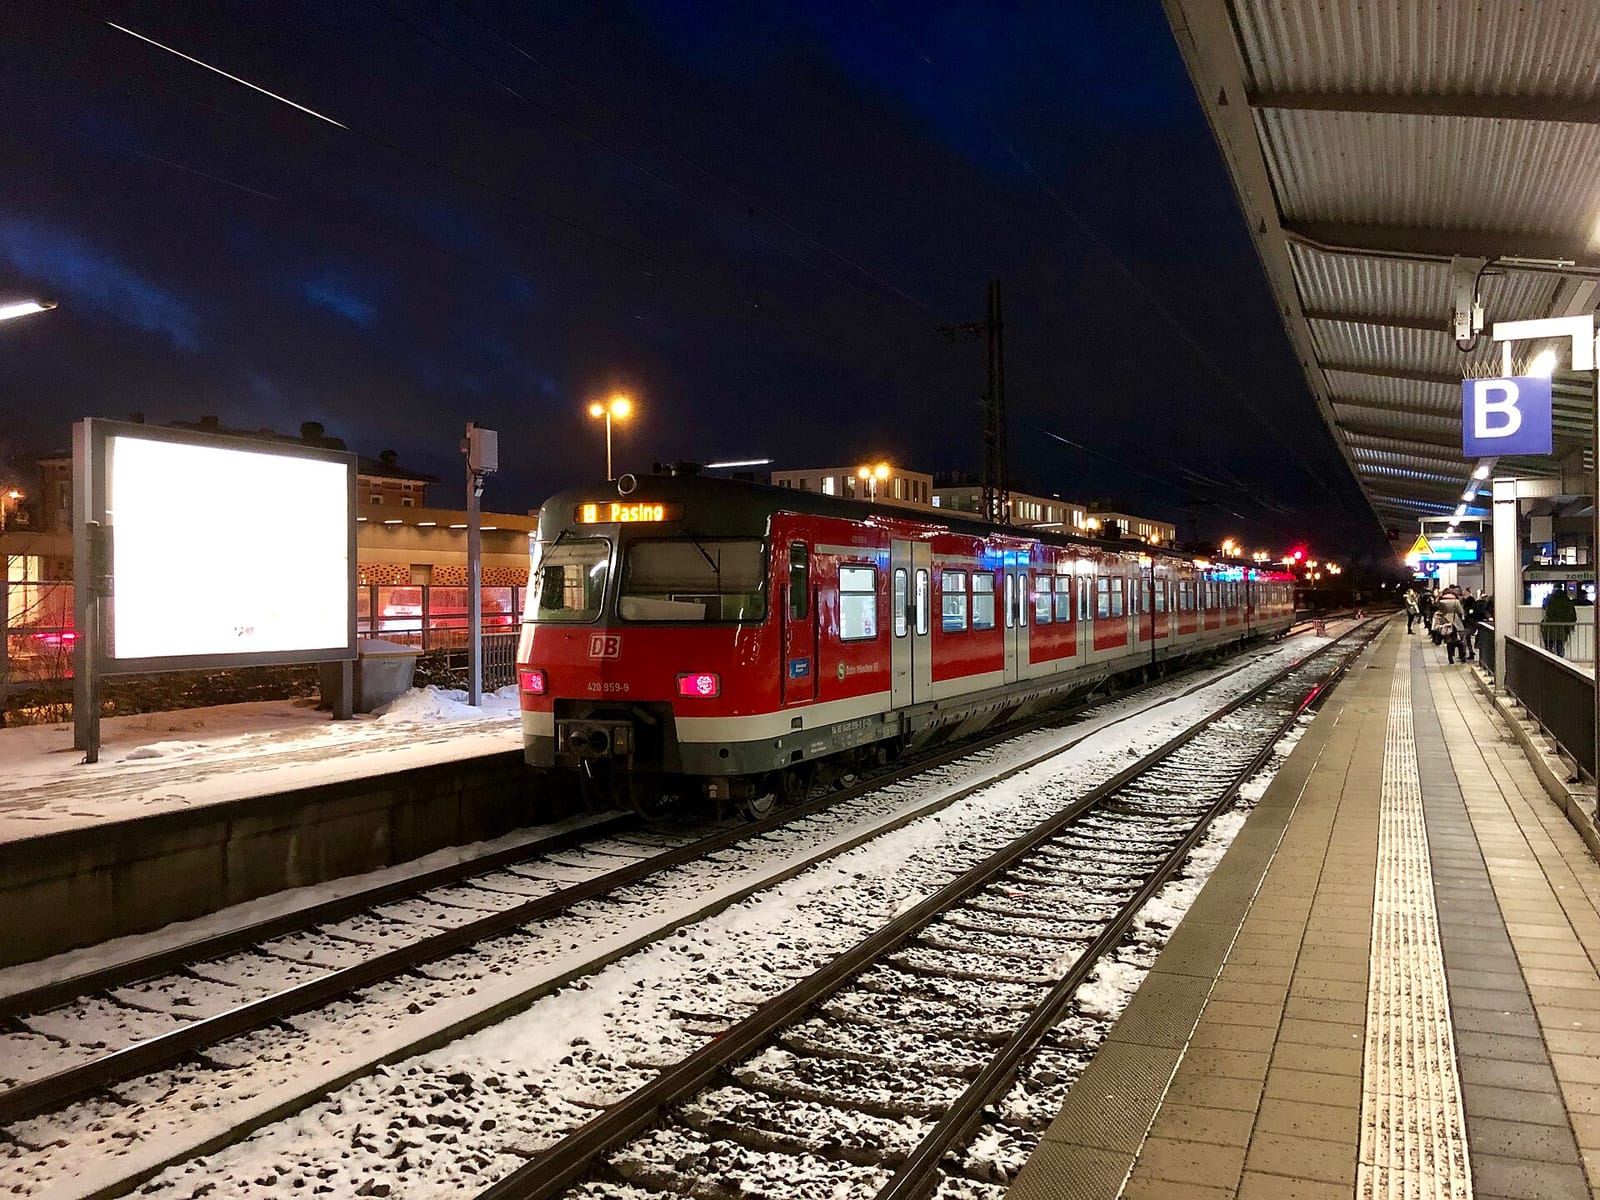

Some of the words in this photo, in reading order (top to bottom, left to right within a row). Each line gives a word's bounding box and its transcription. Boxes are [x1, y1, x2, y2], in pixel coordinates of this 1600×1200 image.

[1474, 379, 1522, 439] B
[611, 503, 664, 522] Pasing
[590, 635, 621, 658] DB
